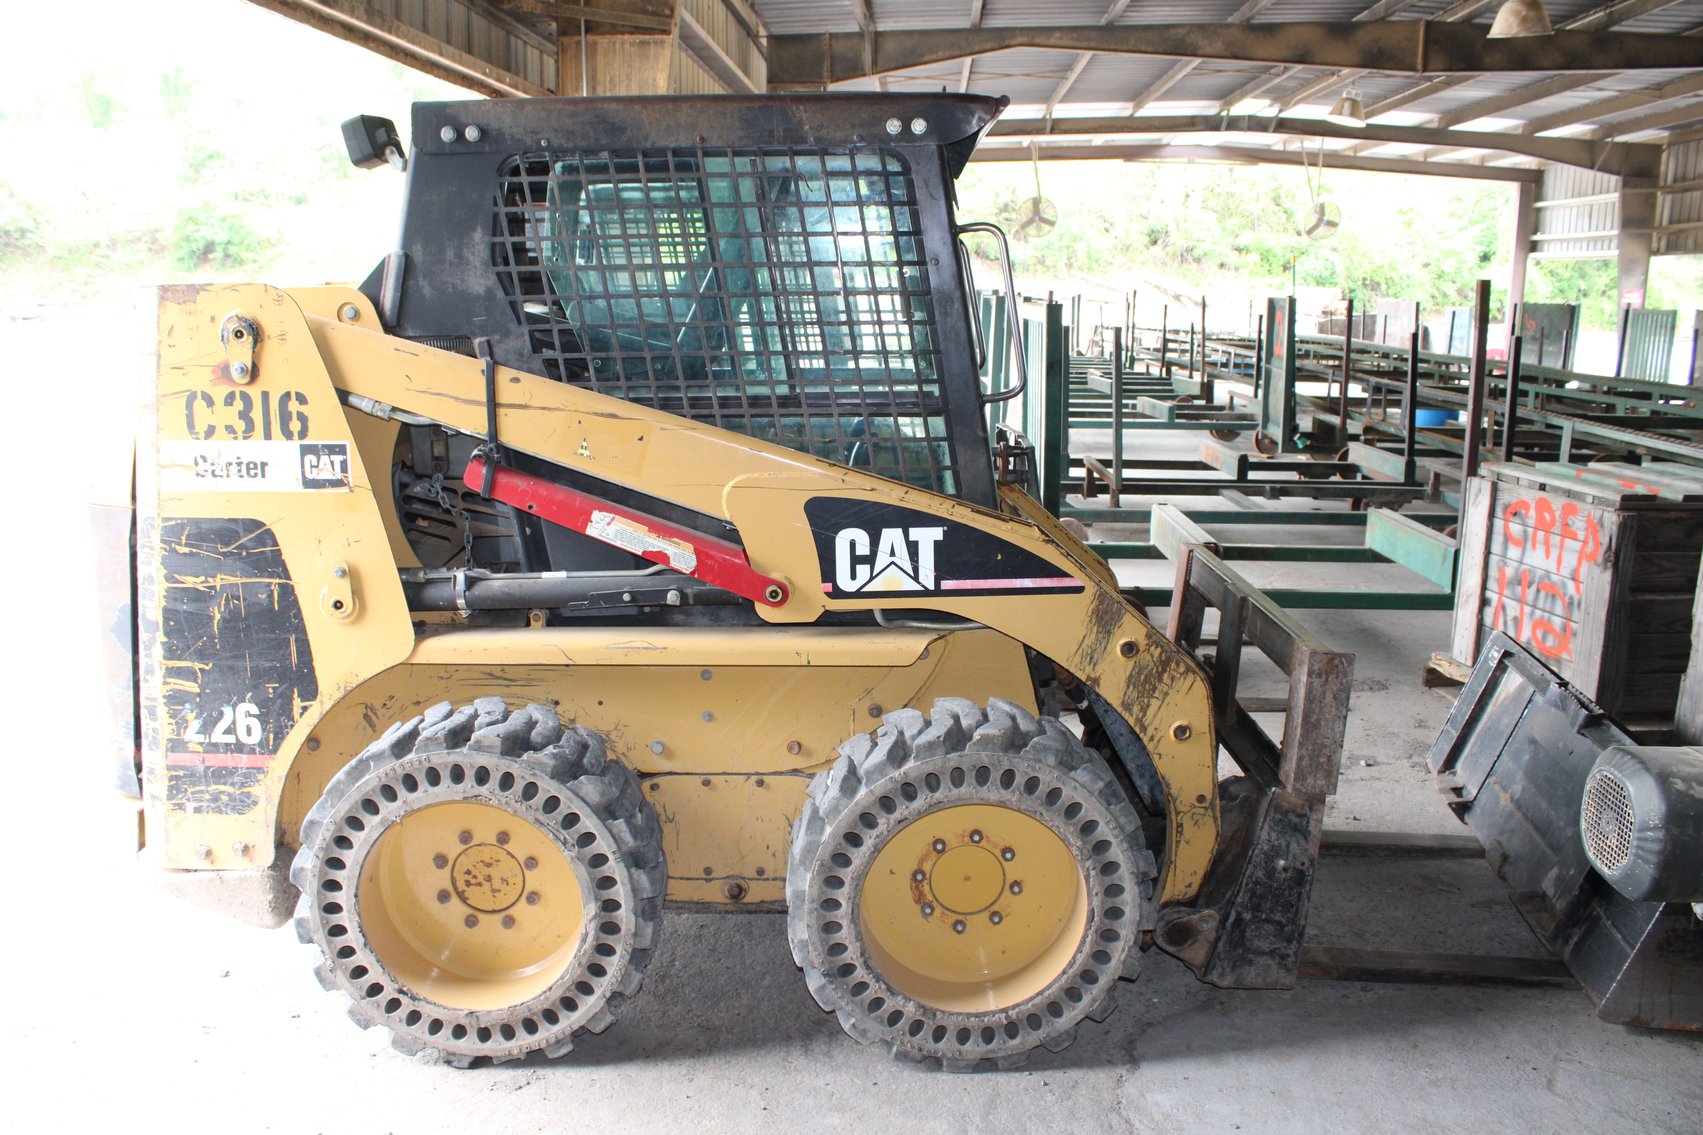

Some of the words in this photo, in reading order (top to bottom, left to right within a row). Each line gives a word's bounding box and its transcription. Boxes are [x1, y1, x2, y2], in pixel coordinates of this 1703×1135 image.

[185, 389, 309, 441] C316
[193, 454, 268, 479] Carter
[303, 454, 346, 480] CAT
[835, 526, 944, 592] CAT
